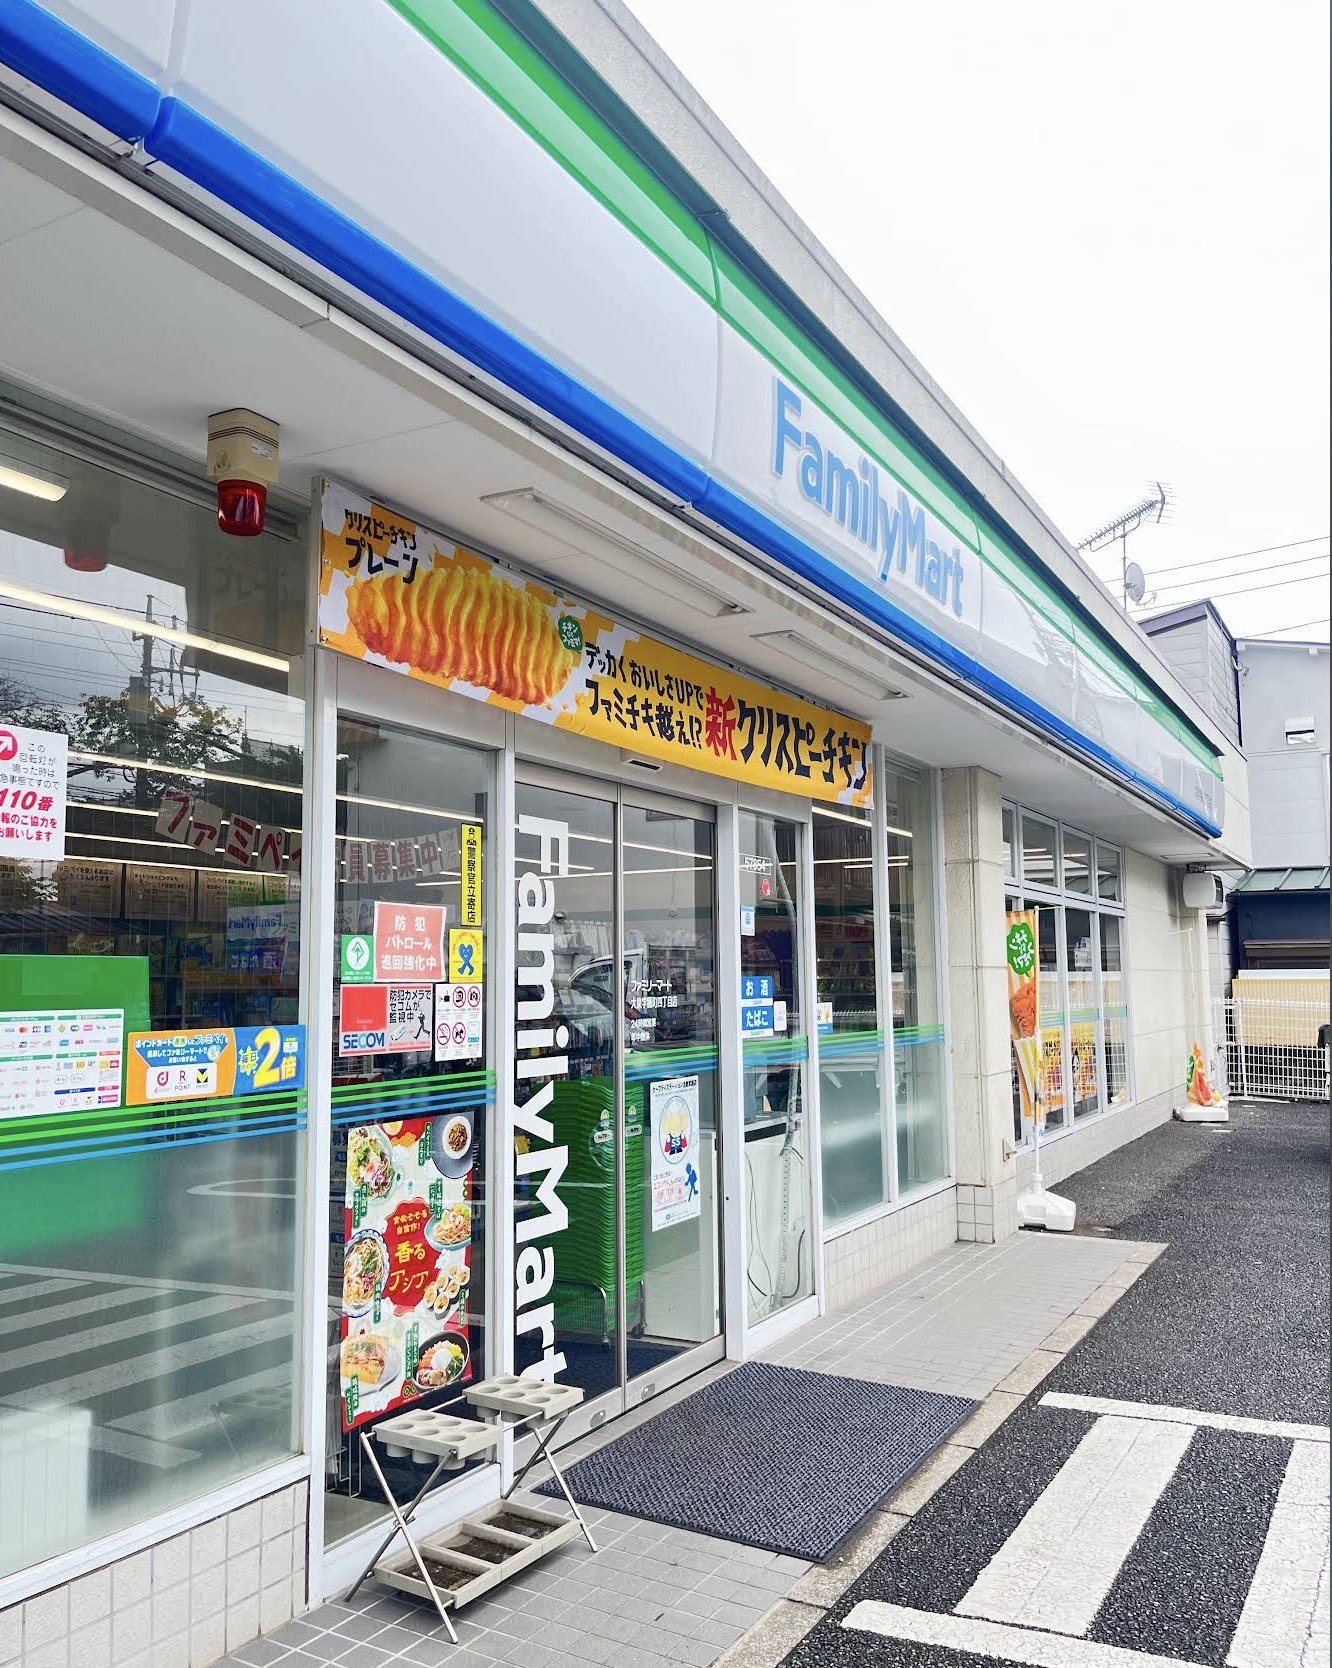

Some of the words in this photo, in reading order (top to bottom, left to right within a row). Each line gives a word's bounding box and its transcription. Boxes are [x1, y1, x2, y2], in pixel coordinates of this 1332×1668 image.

[774, 377, 964, 617] FamilyMart
[344, 509, 417, 551] クリスピーチキン
[346, 537, 419, 585] プレーン
[584, 643, 705, 710] デッカくおいしさUPで
[585, 680, 704, 749] ファミチキ越え!?
[705, 685, 869, 791] 新クリスピーチキン
[28, 742, 46, 753] この
[20, 752, 56, 766] 回転灯が
[12, 763, 55, 778] 鳴った時は
[745, 856, 766, 872] 57854
[394, 914, 427, 932] 防犯
[385, 936, 432, 951] パトロール
[381, 955, 437, 971] 巡回強化中
[631, 979, 673, 992] ファミリーマート
[745, 979, 769, 997] お酒
[389, 989, 431, 1002] 防犯カメラで
[390, 1001, 420, 1012] セコムが
[389, 1011, 414, 1023] 監視中
[746, 1009, 769, 1027] たばこ
[343, 1032, 385, 1050] SECOM
[253, 1027, 297, 1088] 2倍
[175, 1083, 190, 1092] POINT
[513, 813, 569, 1383] FamilyMart
[394, 1240, 426, 1264] 香る
[388, 1269, 429, 1294] アジア
